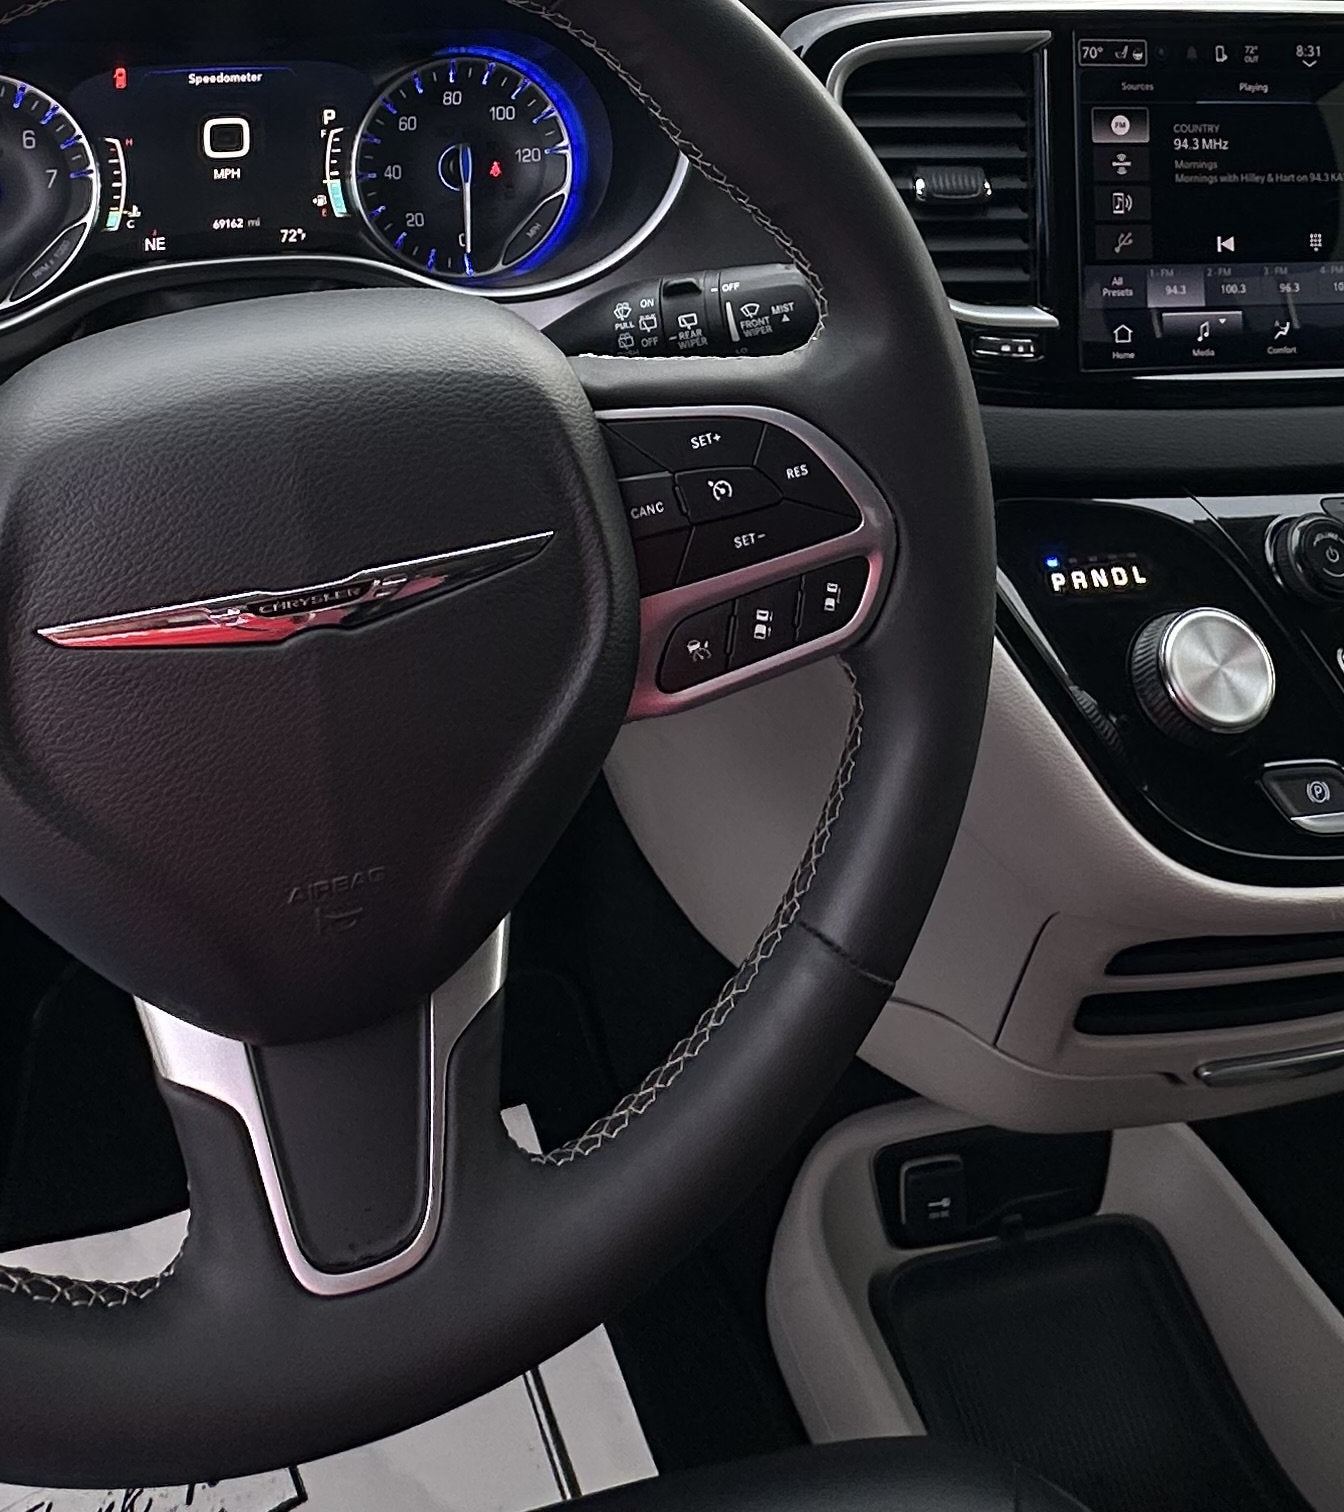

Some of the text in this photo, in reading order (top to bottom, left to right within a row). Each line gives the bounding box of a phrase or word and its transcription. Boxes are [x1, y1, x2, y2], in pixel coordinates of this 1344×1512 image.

[1082, 46, 1104, 60] 70°
[1296, 45, 1321, 58] 8:31
[188, 73, 263, 87] Speedometer
[1121, 82, 1154, 91] Sources
[1239, 82, 1269, 94] Playing
[442, 91, 462, 105] 80
[323, 109, 337, 125] P
[489, 106, 515, 121] 100
[398, 116, 417, 131] 60
[1173, 124, 1220, 134] COUNTRY
[22, 129, 37, 150] 6
[1173, 138, 1229, 151] 94.3 MHz
[515, 148, 541, 163] 120
[1174, 160, 1218, 171] Mornings
[213, 168, 241, 180] MPH
[383, 164, 402, 180] 40
[45, 168, 58, 189] 7
[1175, 174, 1218, 185] Mornings
[1219, 174, 1239, 183] with
[1276, 173, 1295, 183] Hart
[1297, 175, 1308, 183] on
[1309, 173, 1329, 183] 94.3
[126, 220, 135, 229] C
[212, 218, 244, 230] 69162
[405, 212, 424, 228] 20
[144, 237, 166, 252] NE
[722, 282, 740, 292] OFF
[1111, 277, 1124, 286] All
[1102, 288, 1134, 297] Presets
[1166, 285, 1187, 295] 94.3
[1221, 284, 1247, 294] 100.3
[639, 298, 655, 308] ON
[771, 301, 795, 315] MIST
[740, 315, 770, 329] FRONT
[678, 329, 702, 340] REAR
[641, 336, 658, 347] OFF
[1112, 351, 1135, 359] Home
[1192, 348, 1215, 356] Media
[1267, 346, 1297, 354] Comfort
[786, 464, 809, 479] RES
[630, 501, 665, 519] CANC
